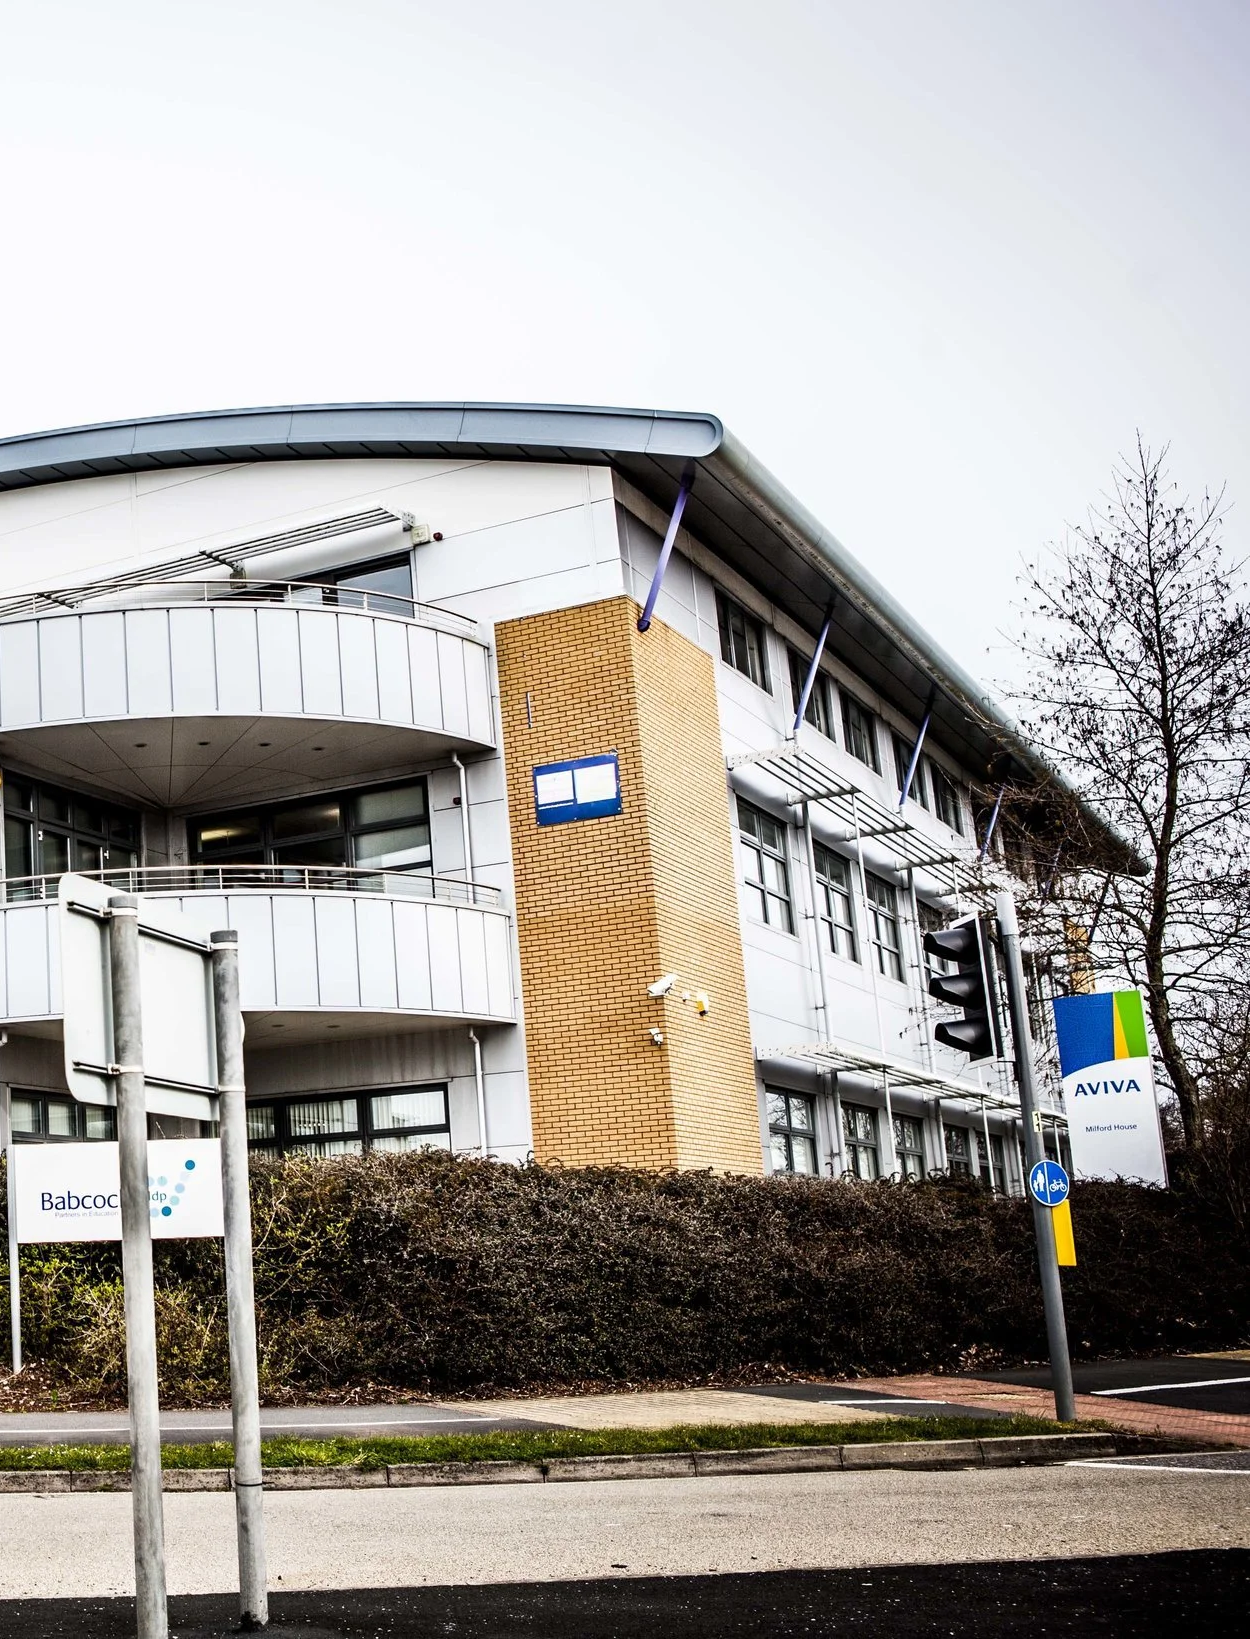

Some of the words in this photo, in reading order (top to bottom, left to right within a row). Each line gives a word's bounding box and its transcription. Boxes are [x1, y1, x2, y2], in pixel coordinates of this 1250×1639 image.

[1075, 1079, 1141, 1097] AVIVA
[1085, 1124, 1112, 1133] Milford
[1114, 1123, 1138, 1132] House
[41, 1190, 119, 1211] Babcoc
